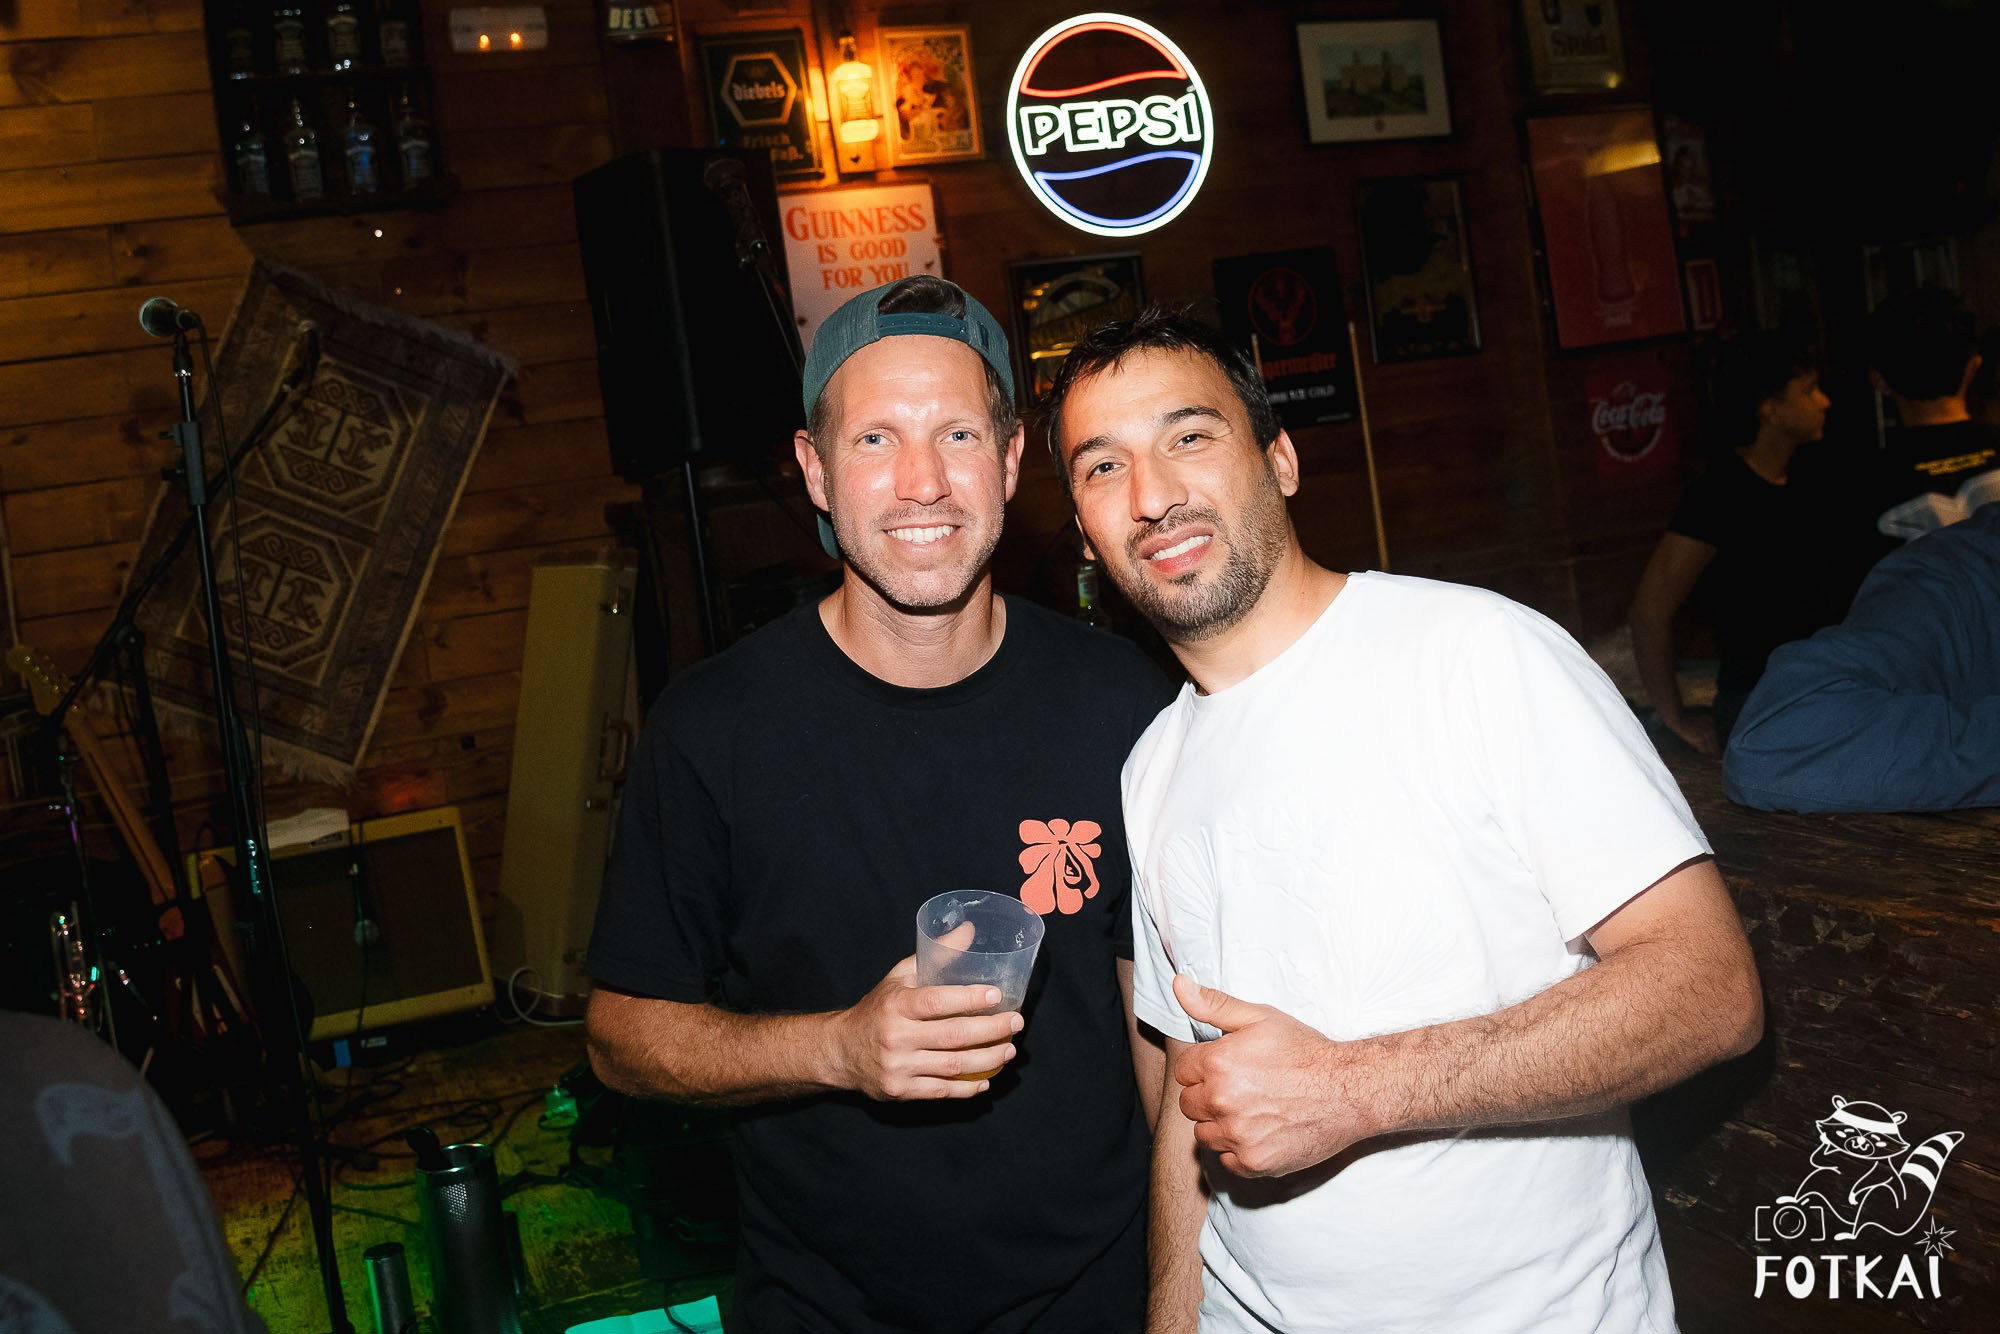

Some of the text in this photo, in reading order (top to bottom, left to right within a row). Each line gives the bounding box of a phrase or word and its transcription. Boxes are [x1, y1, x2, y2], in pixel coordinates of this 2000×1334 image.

[609, 6, 660, 29] BEER
[1020, 93, 1201, 155] PEPSI
[785, 203, 927, 241] GUINNESS
[816, 237, 907, 264] IS GOOD
[822, 262, 910, 290] FOR YOU
